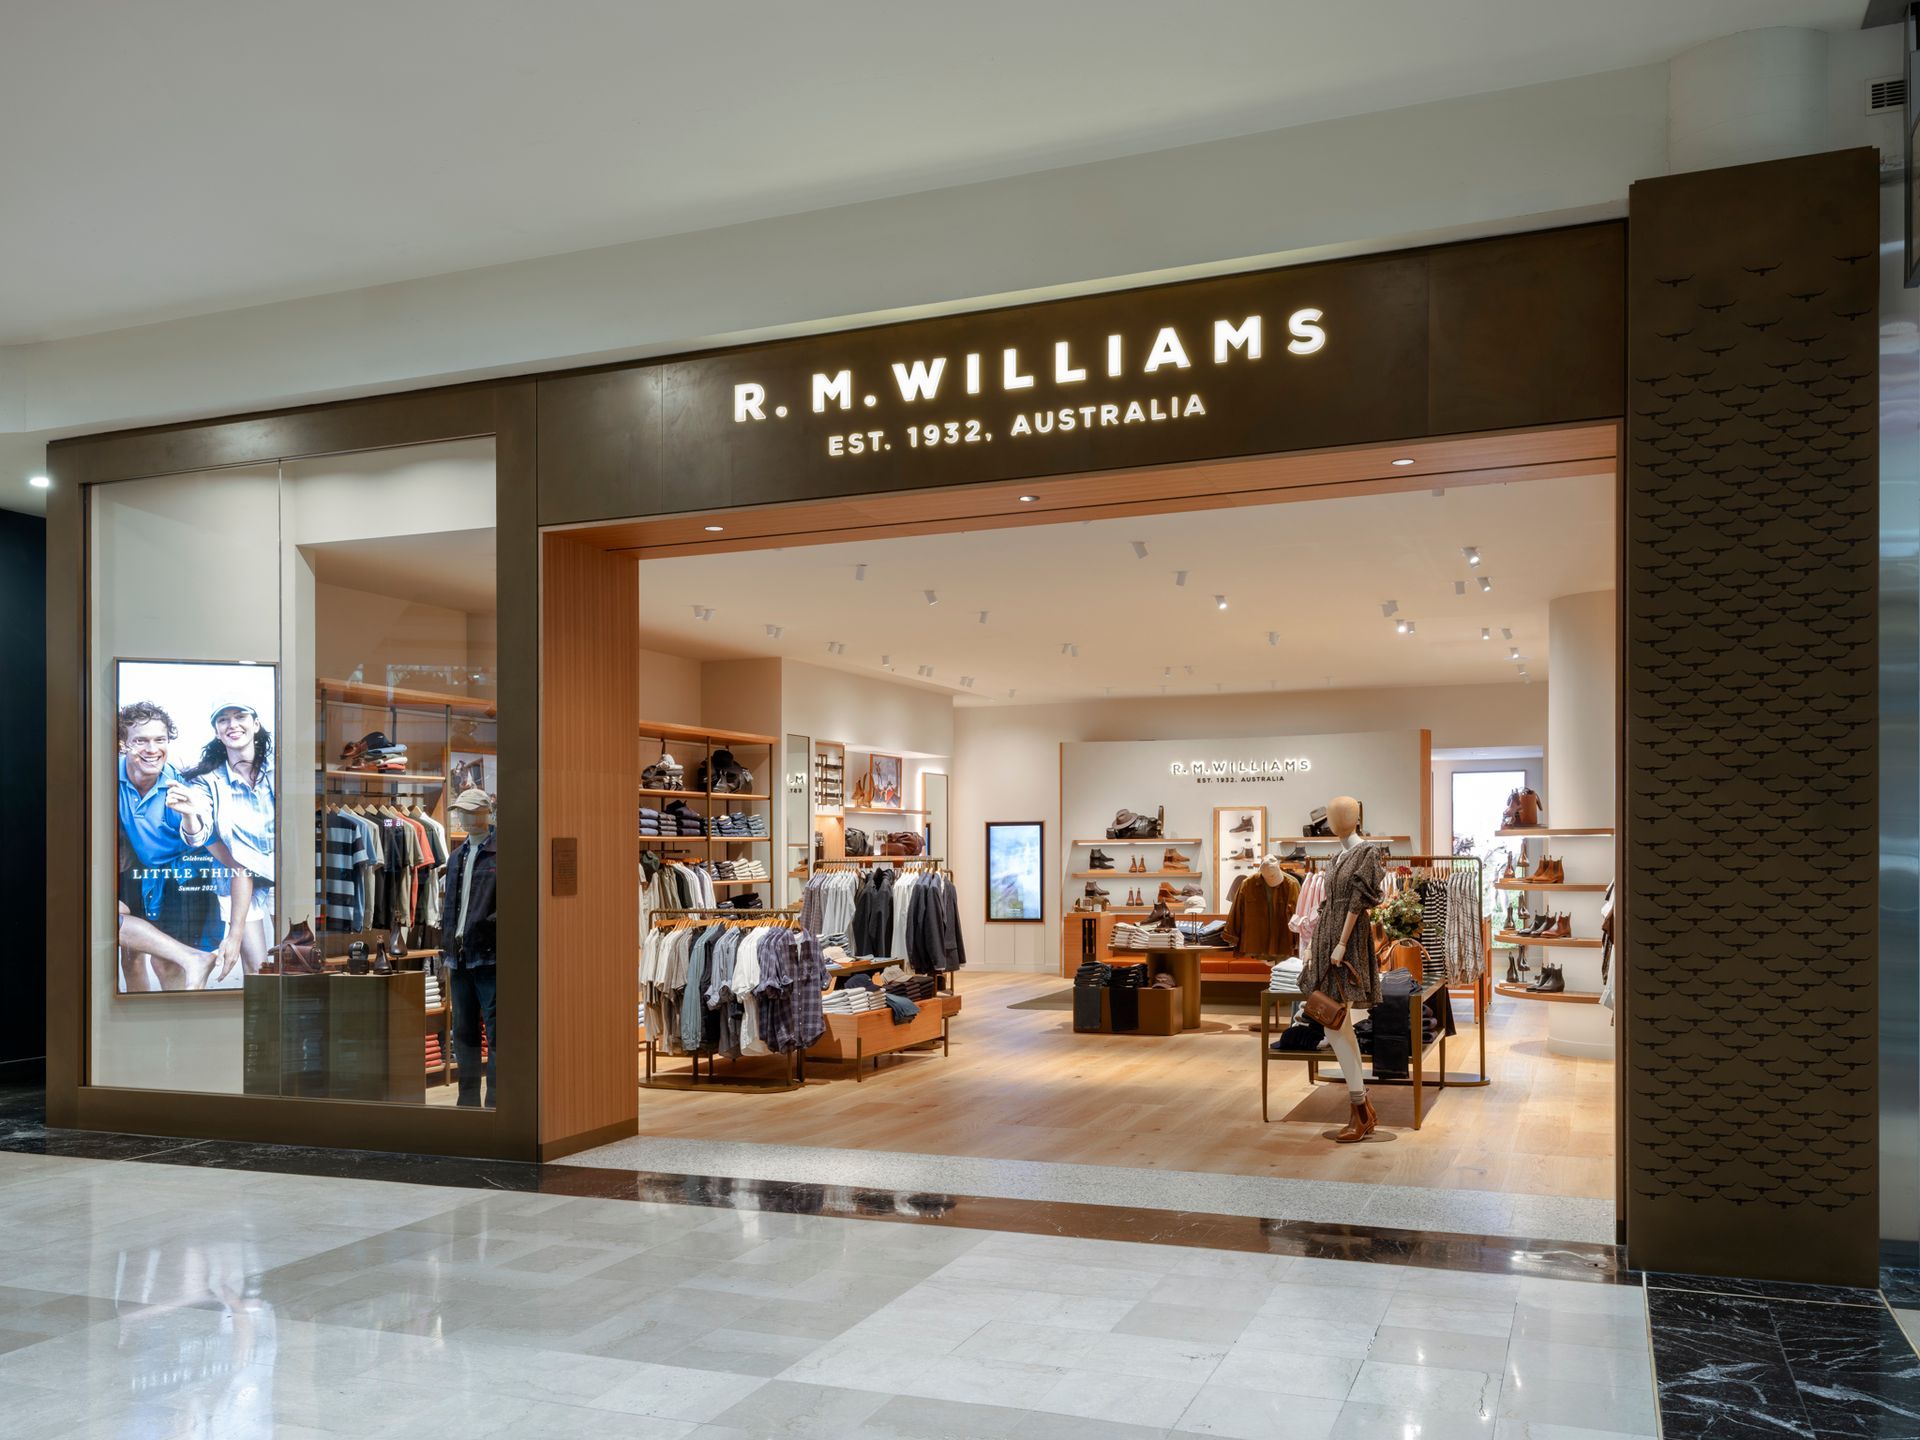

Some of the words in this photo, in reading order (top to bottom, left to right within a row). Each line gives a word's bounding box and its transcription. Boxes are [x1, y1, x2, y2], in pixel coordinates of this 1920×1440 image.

[828, 430, 891, 457] EST.
[906, 419, 992, 448] 1932,
[1010, 394, 1206, 437] AUSTRALIA
[1240, 775, 1285, 783] AUSTRALIA
[182, 855, 214, 863] Celebrating
[133, 868, 193, 879] LITTLE
